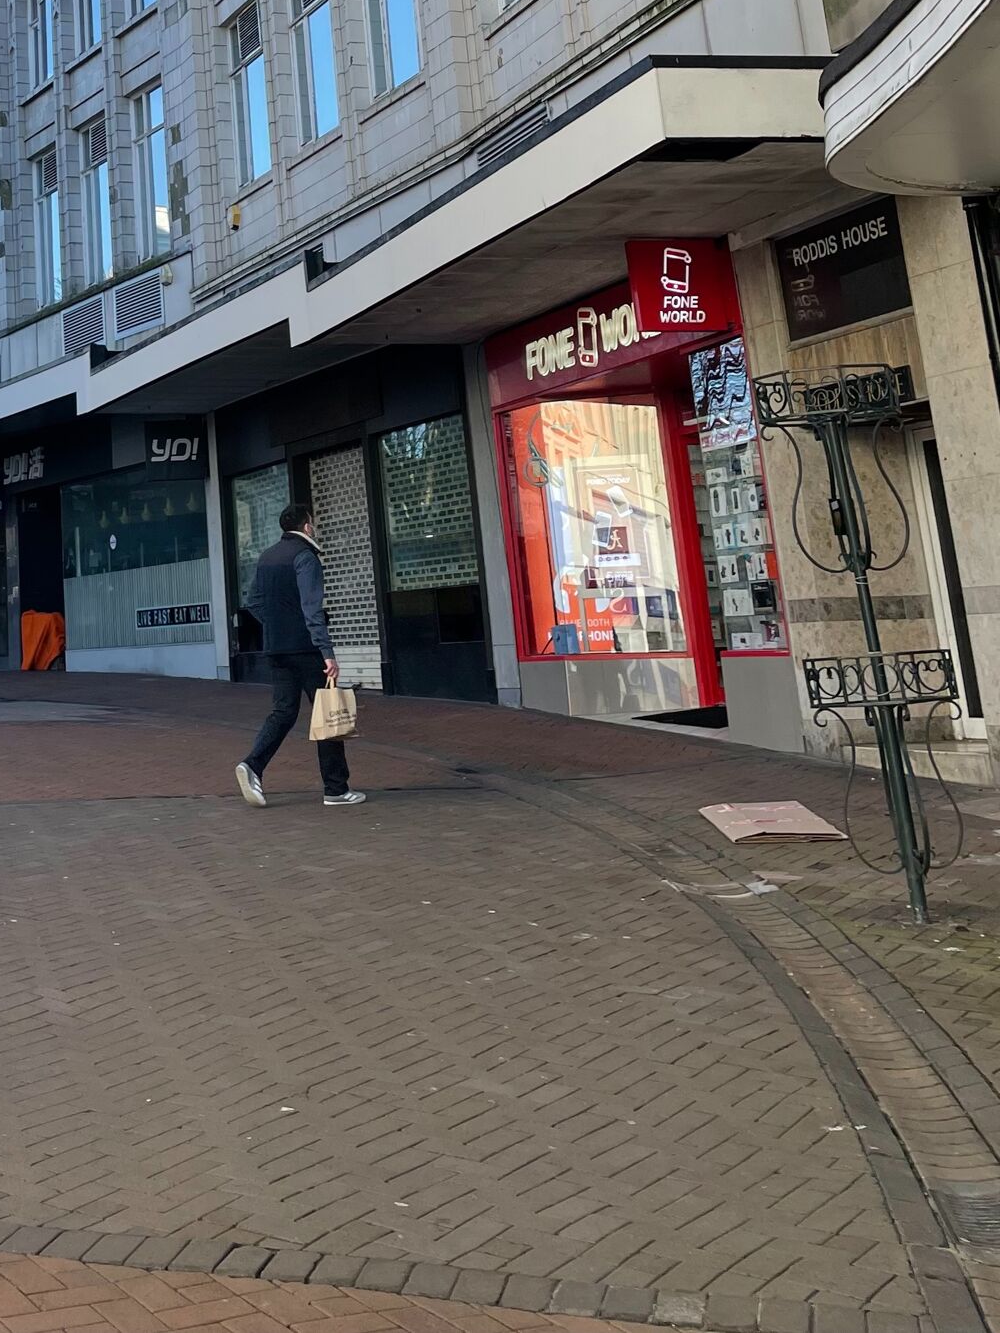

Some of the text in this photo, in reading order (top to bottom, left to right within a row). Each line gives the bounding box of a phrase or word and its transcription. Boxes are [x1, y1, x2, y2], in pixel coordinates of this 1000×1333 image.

[792, 216, 888, 266] RODDIS HOUSE
[664, 296, 699, 309] FONE
[660, 310, 706, 324] WORLD
[525, 326, 576, 381] FONE
[151, 437, 199, 462] YO!
[3, 452, 28, 485] YO!
[137, 611, 152, 626] LIVE
[174, 608, 187, 623] EAT
[189, 606, 209, 622] WELL
